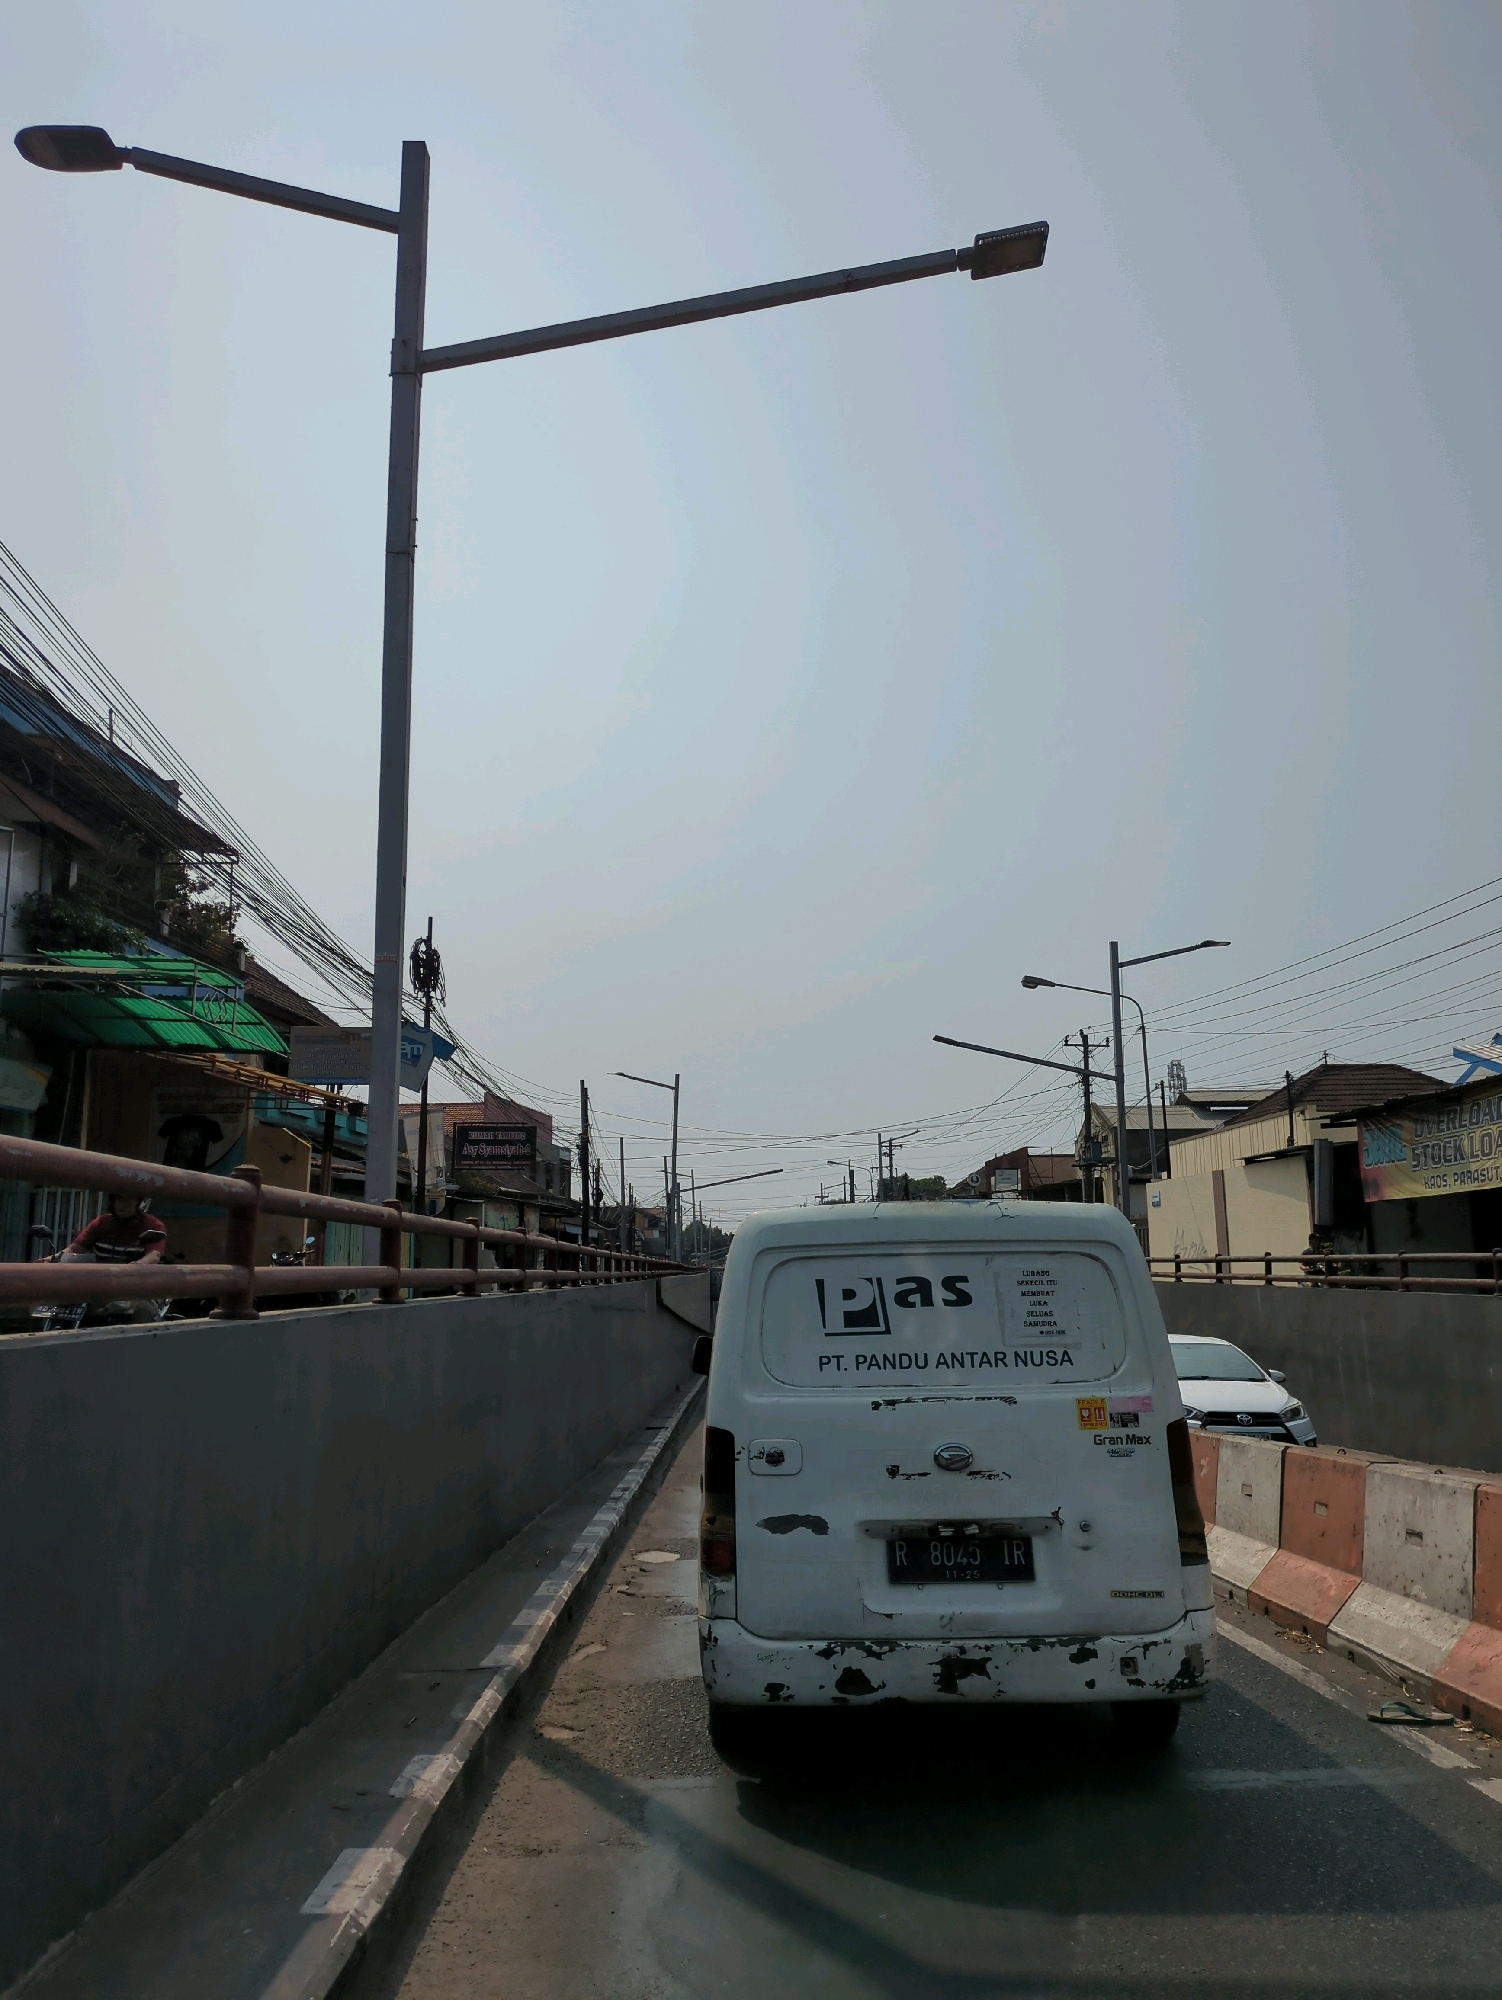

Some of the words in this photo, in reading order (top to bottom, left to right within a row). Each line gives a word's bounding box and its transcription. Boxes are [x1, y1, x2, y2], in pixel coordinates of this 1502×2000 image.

[462, 1142, 478, 1158] Asy
[1411, 1134, 1467, 1171] STOCK
[1424, 1173, 1451, 1189] KAOS,
[1023, 1320, 1058, 1328] SAMUDRA
[818, 1355, 848, 1372] PT.
[855, 1353, 929, 1371] PANDU
[935, 1351, 1008, 1369] ANTAR
[1014, 1349, 1074, 1367] NUSA
[1078, 1398, 1105, 1406] FRAGILE
[1093, 1434, 1124, 1446] Gran
[1125, 1433, 1152, 1445] Max
[895, 1541, 907, 1566] R
[930, 1540, 981, 1567] 8045
